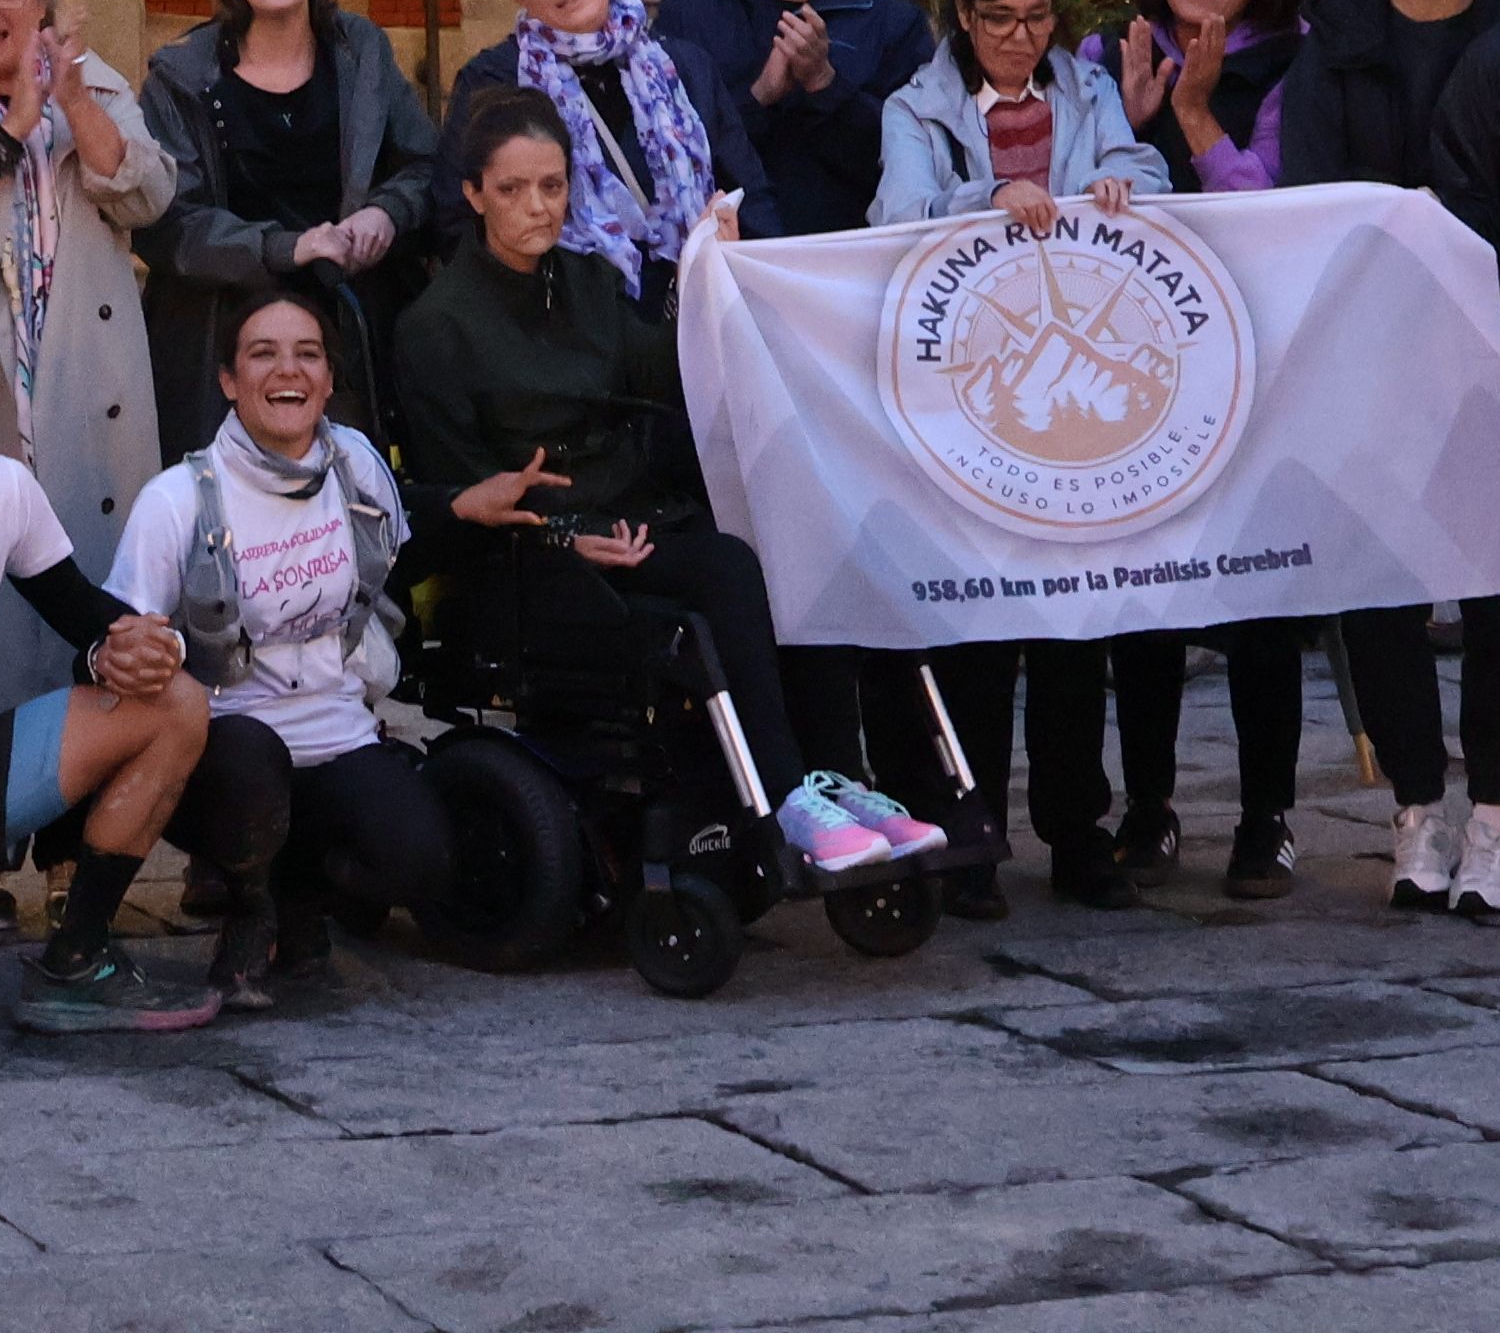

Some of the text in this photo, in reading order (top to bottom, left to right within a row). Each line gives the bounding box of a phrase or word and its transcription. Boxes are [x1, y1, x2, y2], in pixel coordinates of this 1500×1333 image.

[916, 236, 998, 361] HAKUNA
[1091, 222, 1210, 336] MATATA
[946, 414, 1217, 515] INCLUSO LO IMPOSIBLE
[978, 446, 1039, 484] TODO
[1054, 477, 1080, 492] ES
[241, 547, 350, 600] LA SONRISA
[912, 543, 1313, 603] 958,60 km por la Parálisis Cerebral
[689, 835, 731, 856] QUICKIE
